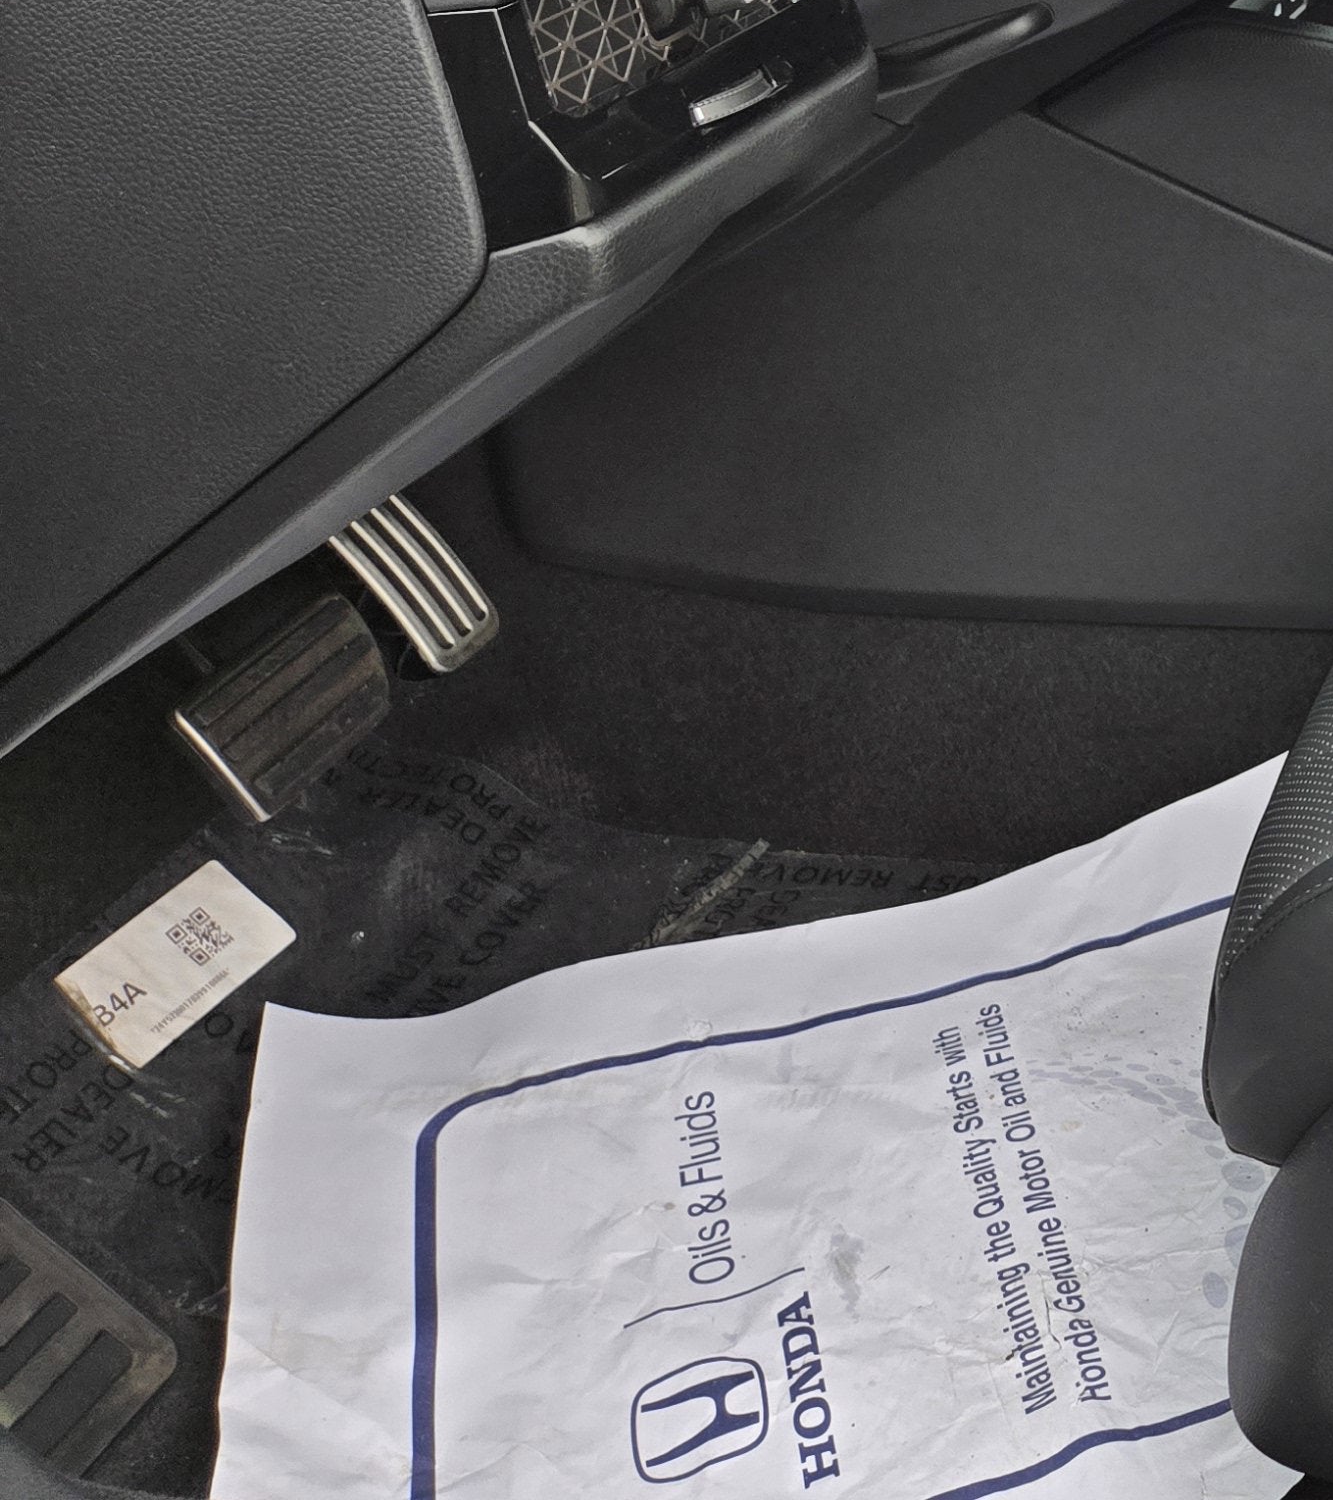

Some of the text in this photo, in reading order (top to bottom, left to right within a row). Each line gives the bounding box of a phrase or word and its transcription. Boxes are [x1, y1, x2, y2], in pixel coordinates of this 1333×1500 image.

[445, 815, 550, 918] REMOVE
[674, 1091, 735, 1284] Oils & Fluids
[932, 1026, 1057, 1415] Maintaining the Quality Starts with
[975, 1003, 1112, 1402] Honda Genuine Motor Oil and Fluids
[777, 1291, 840, 1489] HONDA
